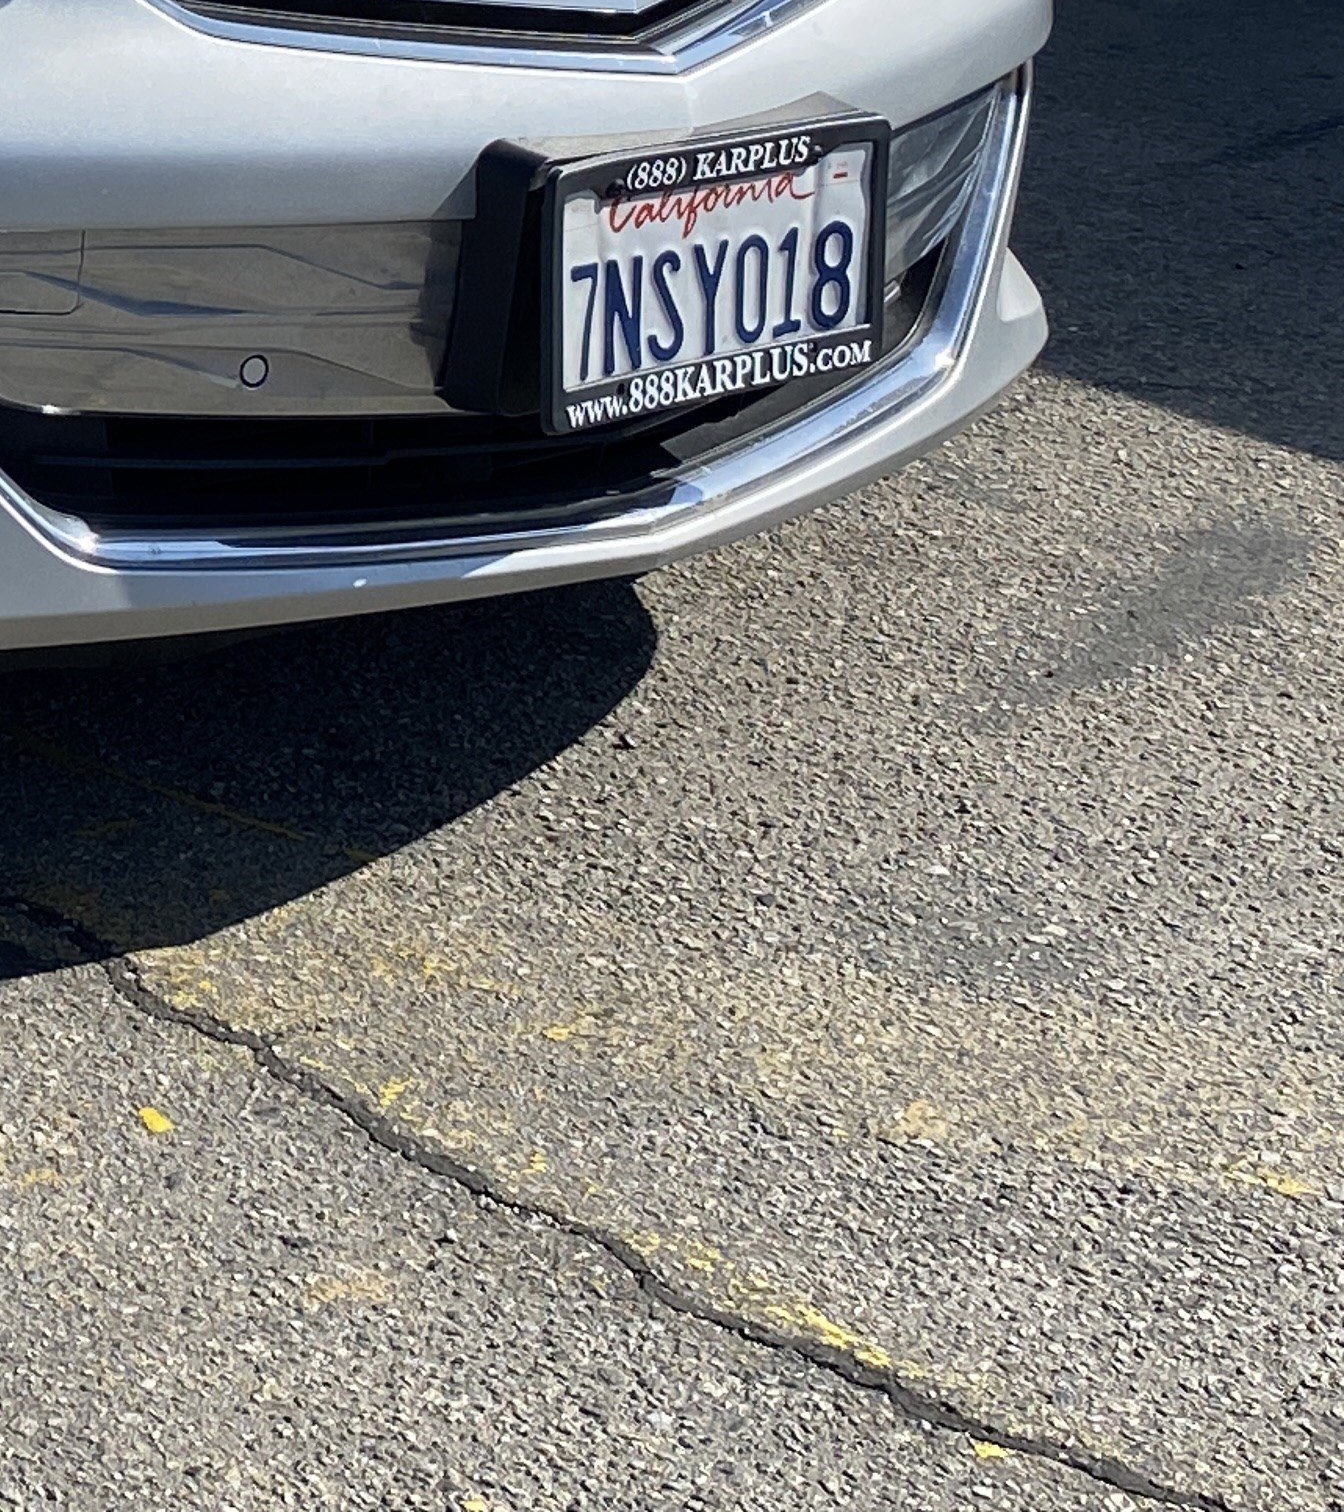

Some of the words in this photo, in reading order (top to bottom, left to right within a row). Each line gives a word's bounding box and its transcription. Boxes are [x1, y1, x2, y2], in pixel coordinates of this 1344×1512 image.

[626, 158, 687, 191] (888)
[693, 136, 812, 181] KARPLUS
[608, 171, 816, 240] California
[569, 219, 855, 382] 7NSY018
